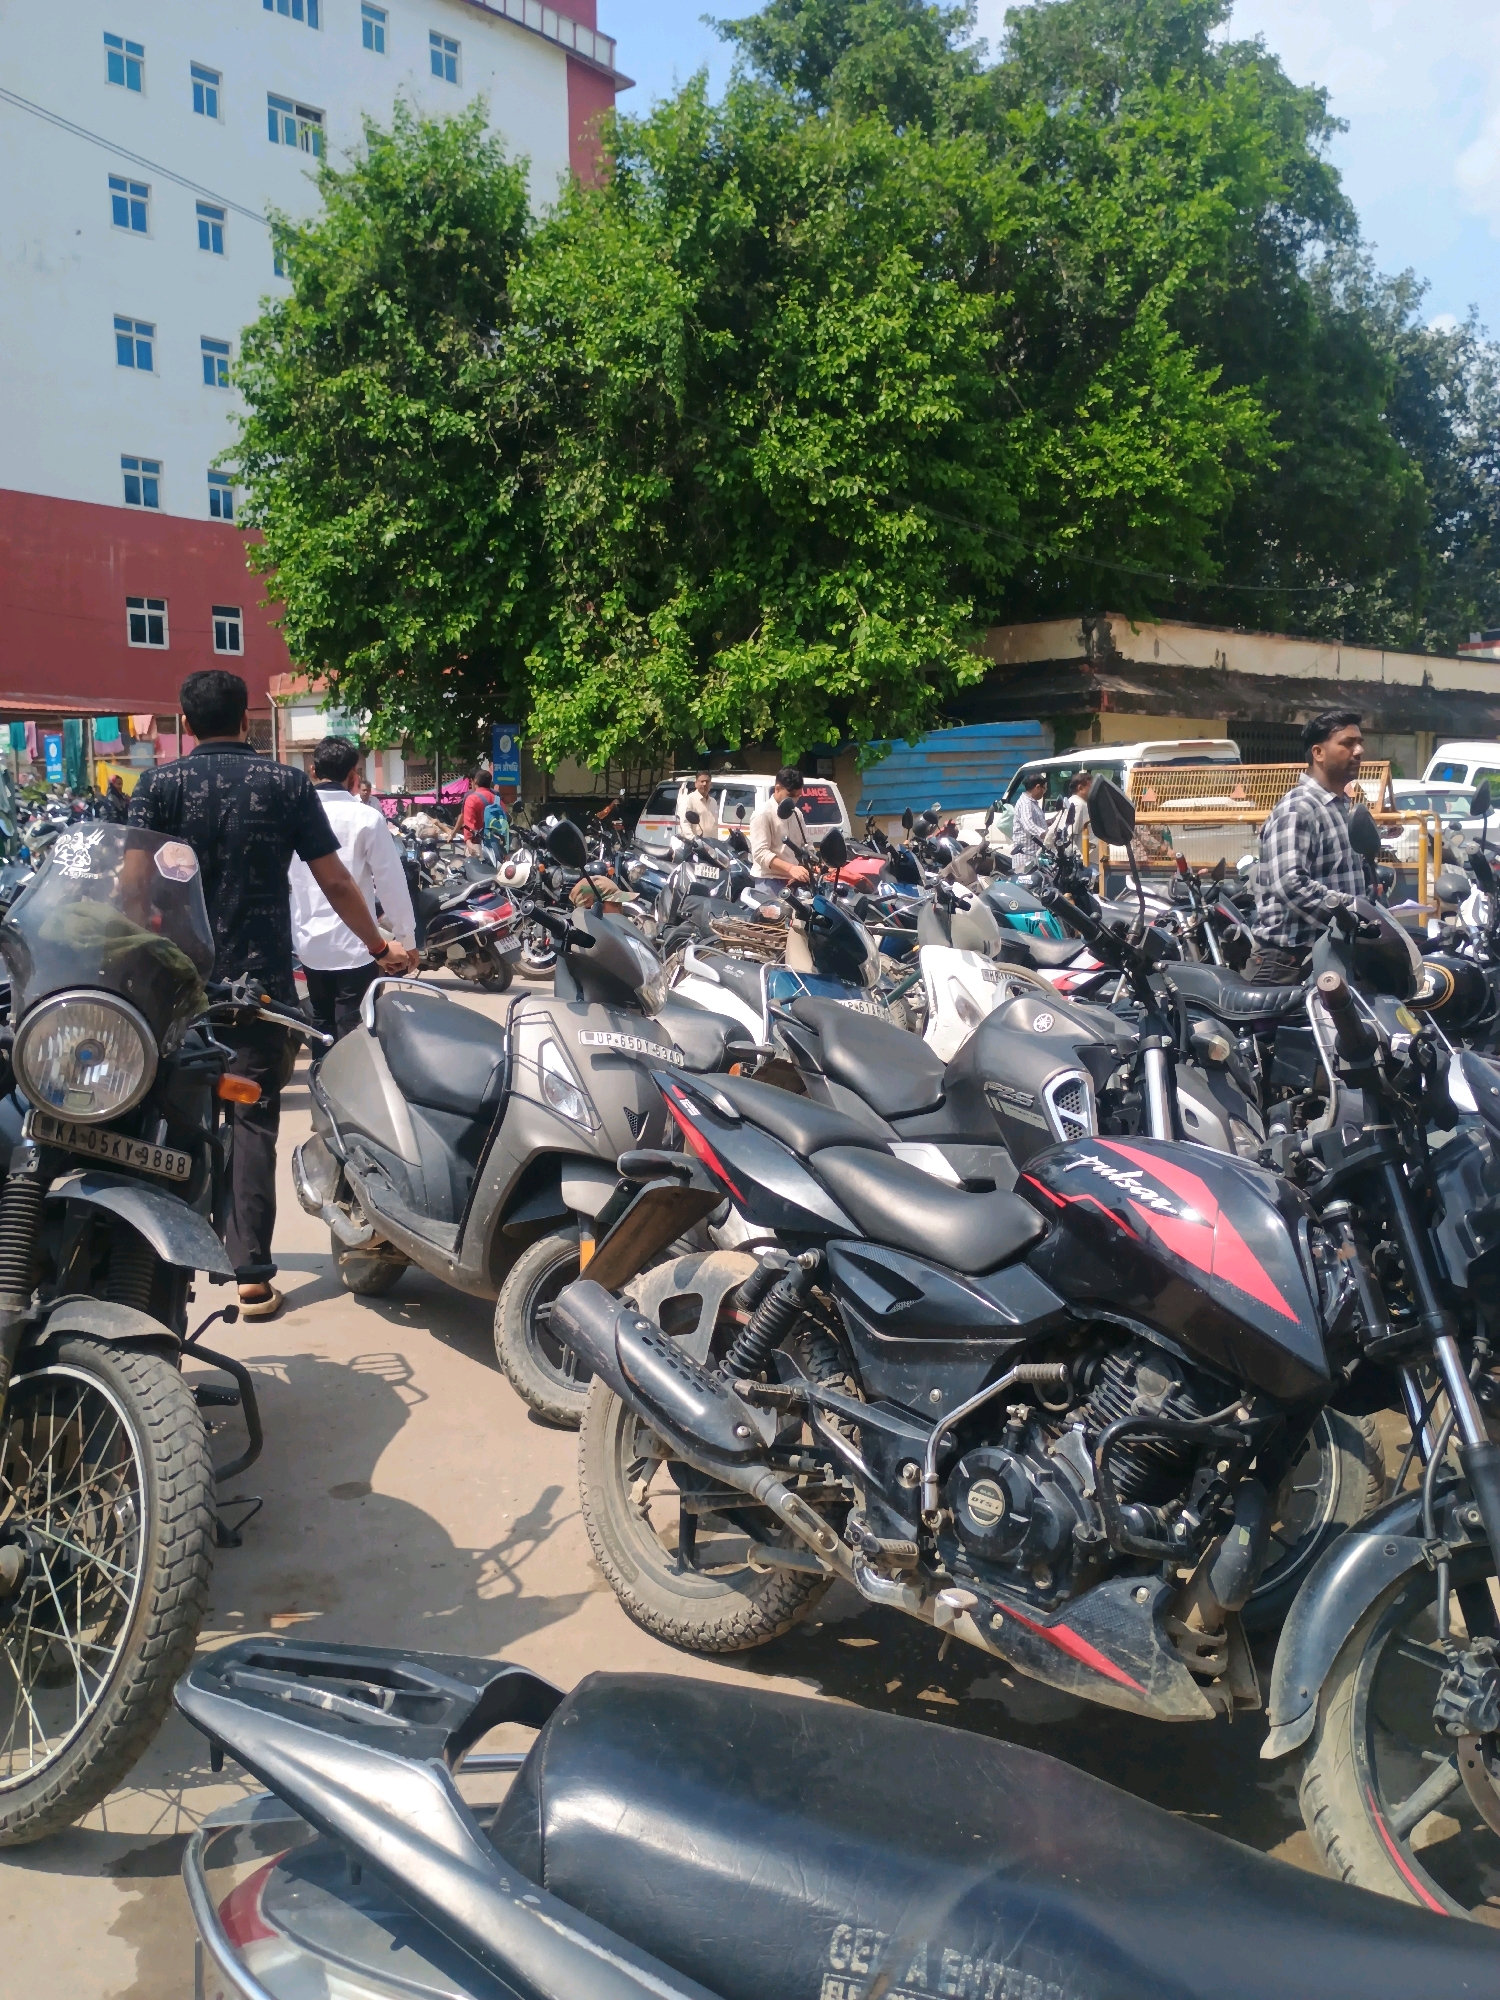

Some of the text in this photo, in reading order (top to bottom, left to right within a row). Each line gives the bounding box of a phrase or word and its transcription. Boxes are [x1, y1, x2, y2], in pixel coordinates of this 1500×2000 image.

[802, 787, 828, 797] LANCE
[597, 1032, 613, 1045] UP
[55, 1120, 77, 1146] KA
[139, 1146, 186, 1175] 9888
